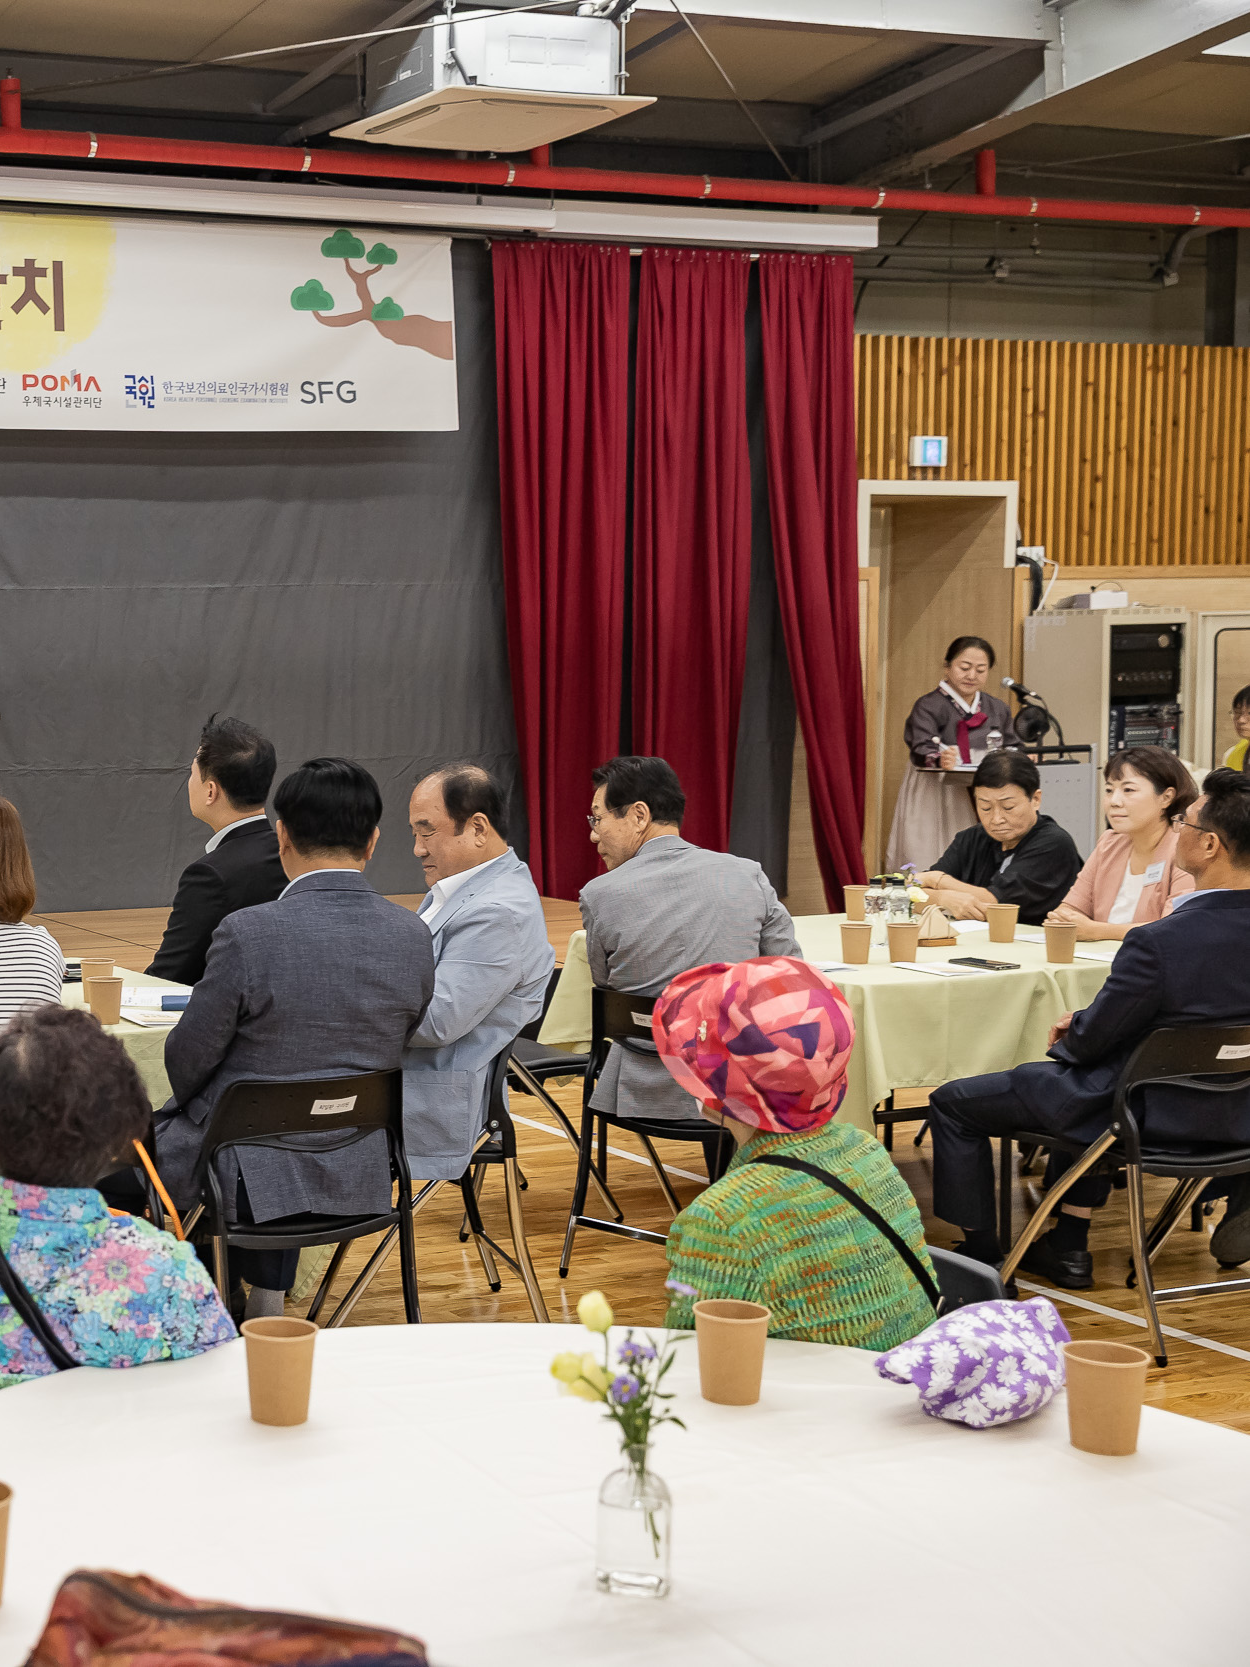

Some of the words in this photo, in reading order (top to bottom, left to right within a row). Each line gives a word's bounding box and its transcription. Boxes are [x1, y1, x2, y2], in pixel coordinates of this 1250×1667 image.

[21, 369, 103, 392] POMA
[161, 381, 290, 397] 한국보건의료인국가시험원
[22, 395, 103, 409] 우체국시설관리단
[299, 380, 358, 405] SFG
